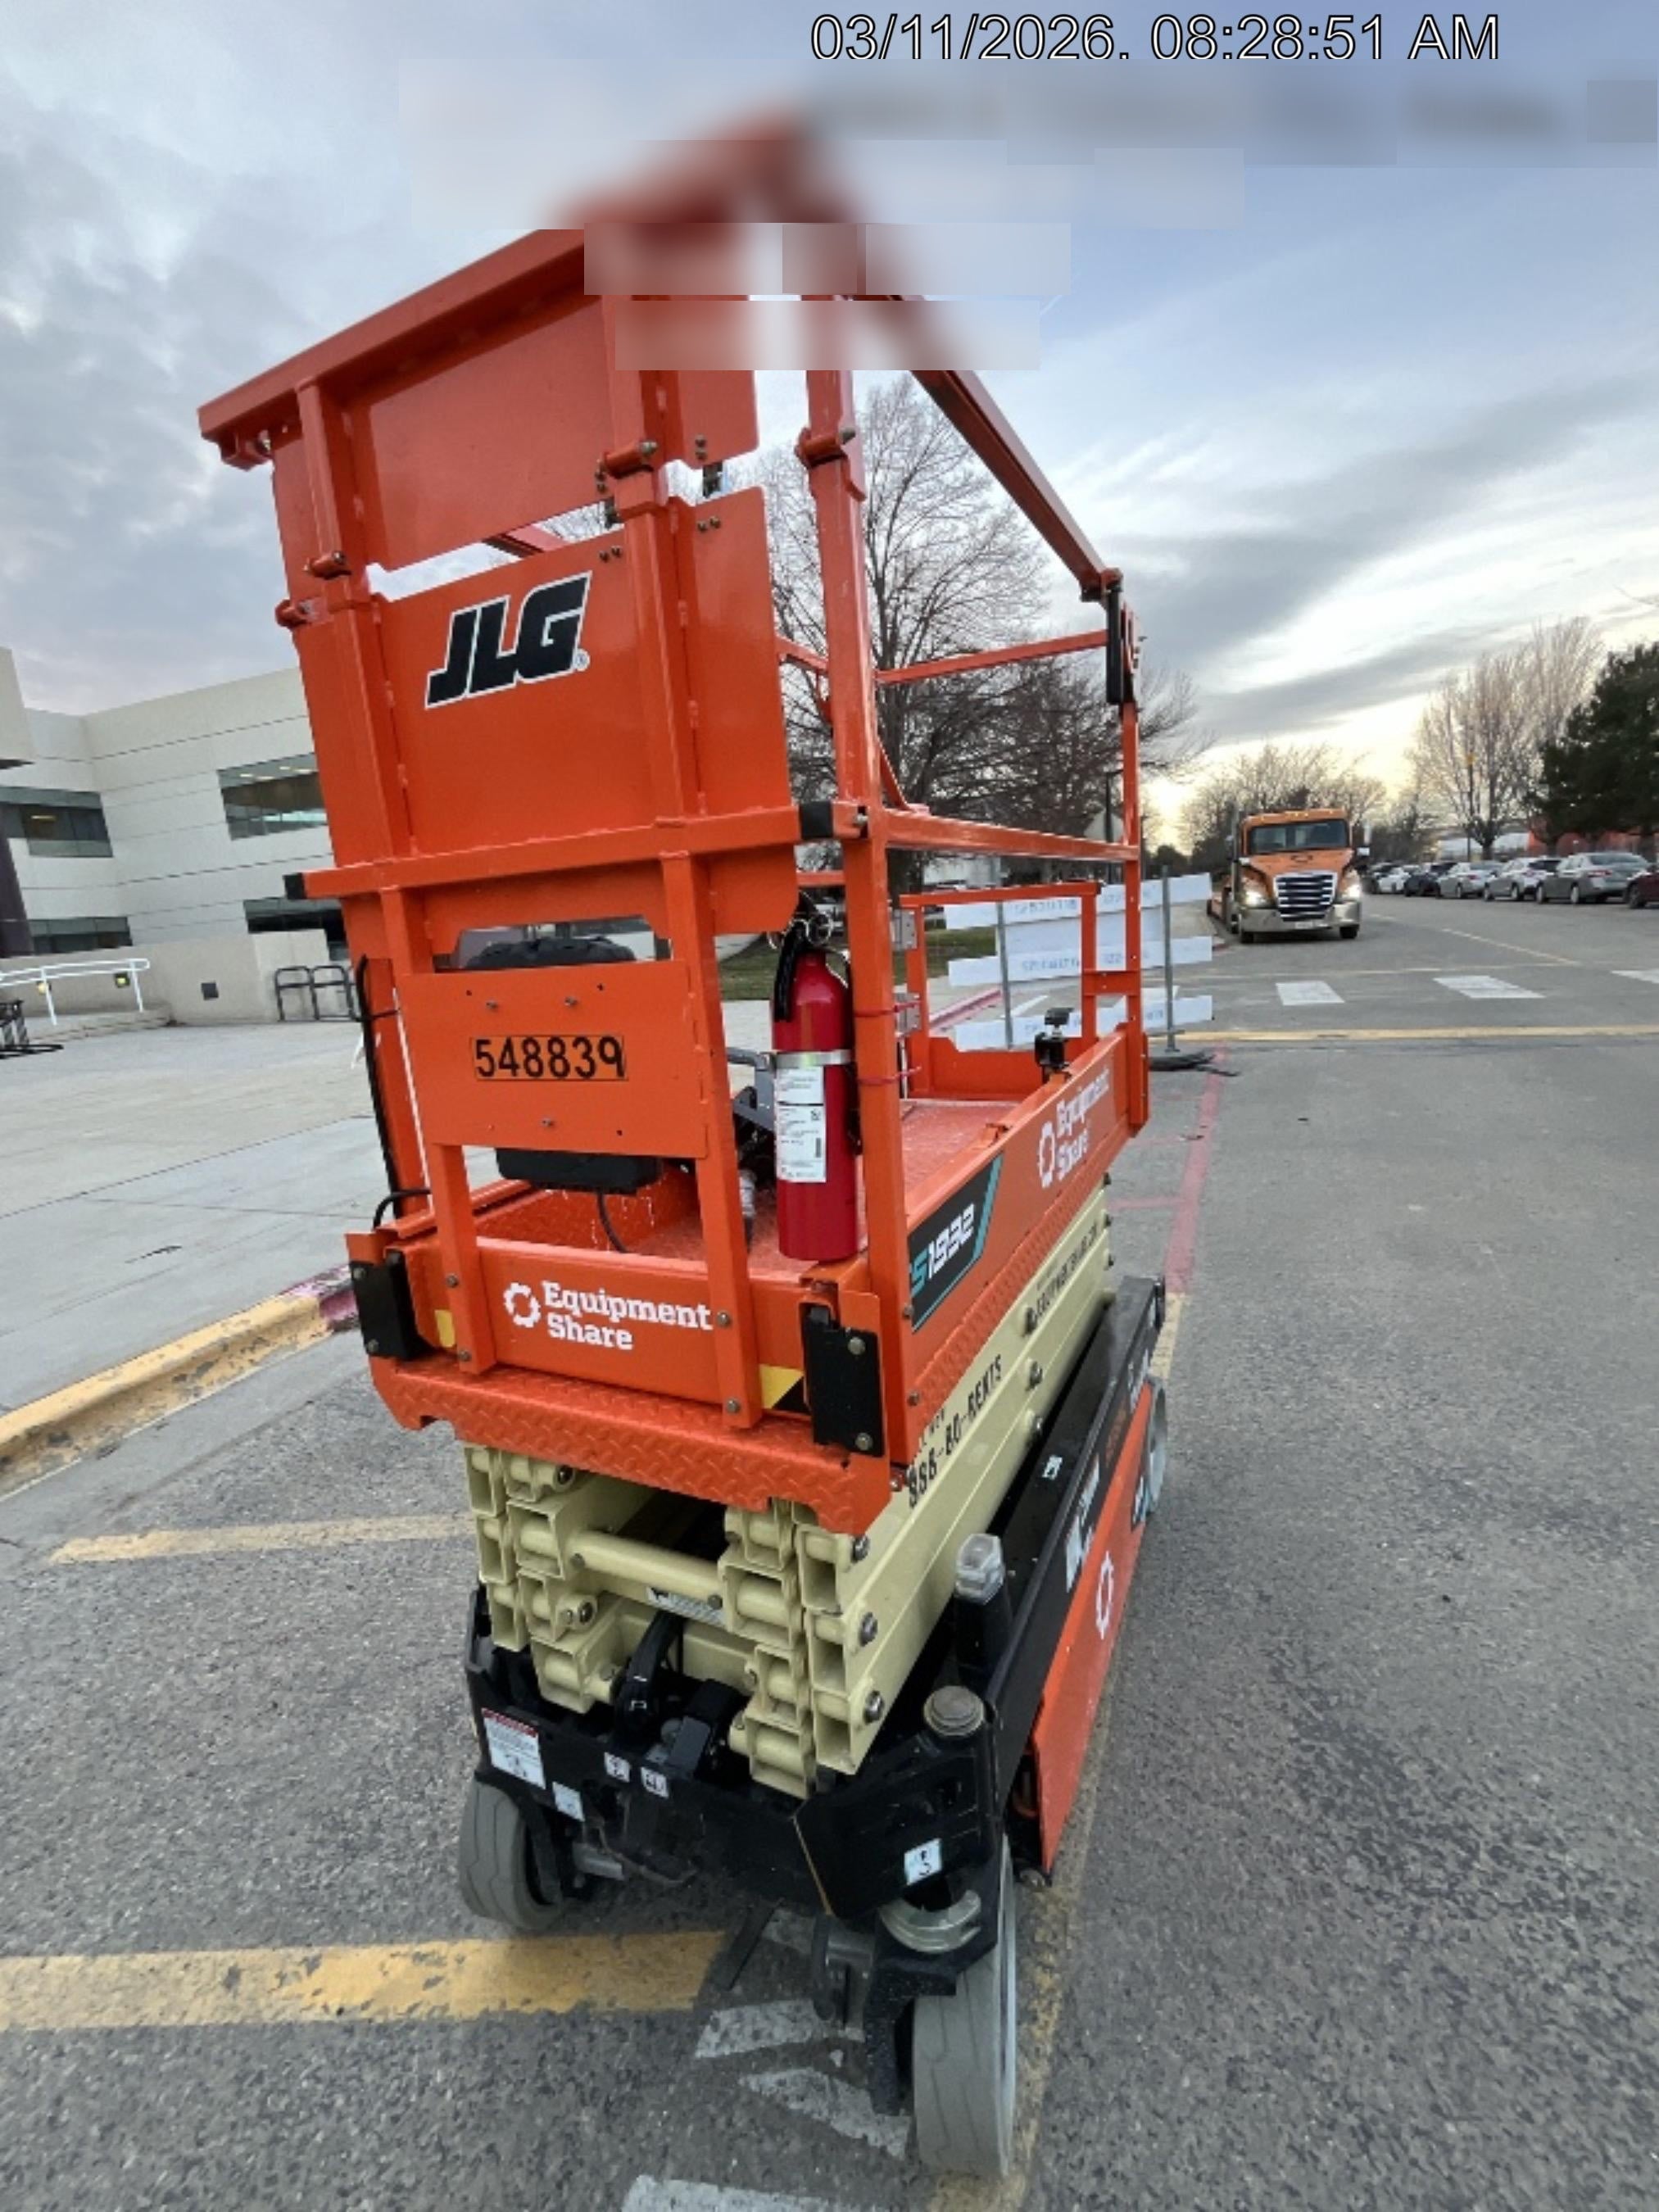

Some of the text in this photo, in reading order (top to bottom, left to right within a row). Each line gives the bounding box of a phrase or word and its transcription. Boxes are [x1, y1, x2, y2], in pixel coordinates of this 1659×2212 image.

[424, 570, 592, 710] JLG
[475, 1036, 625, 1079] 548839
[911, 1203, 975, 1296] S1932
[541, 1280, 714, 1330] Equipment
[546, 1312, 634, 1351] Share
